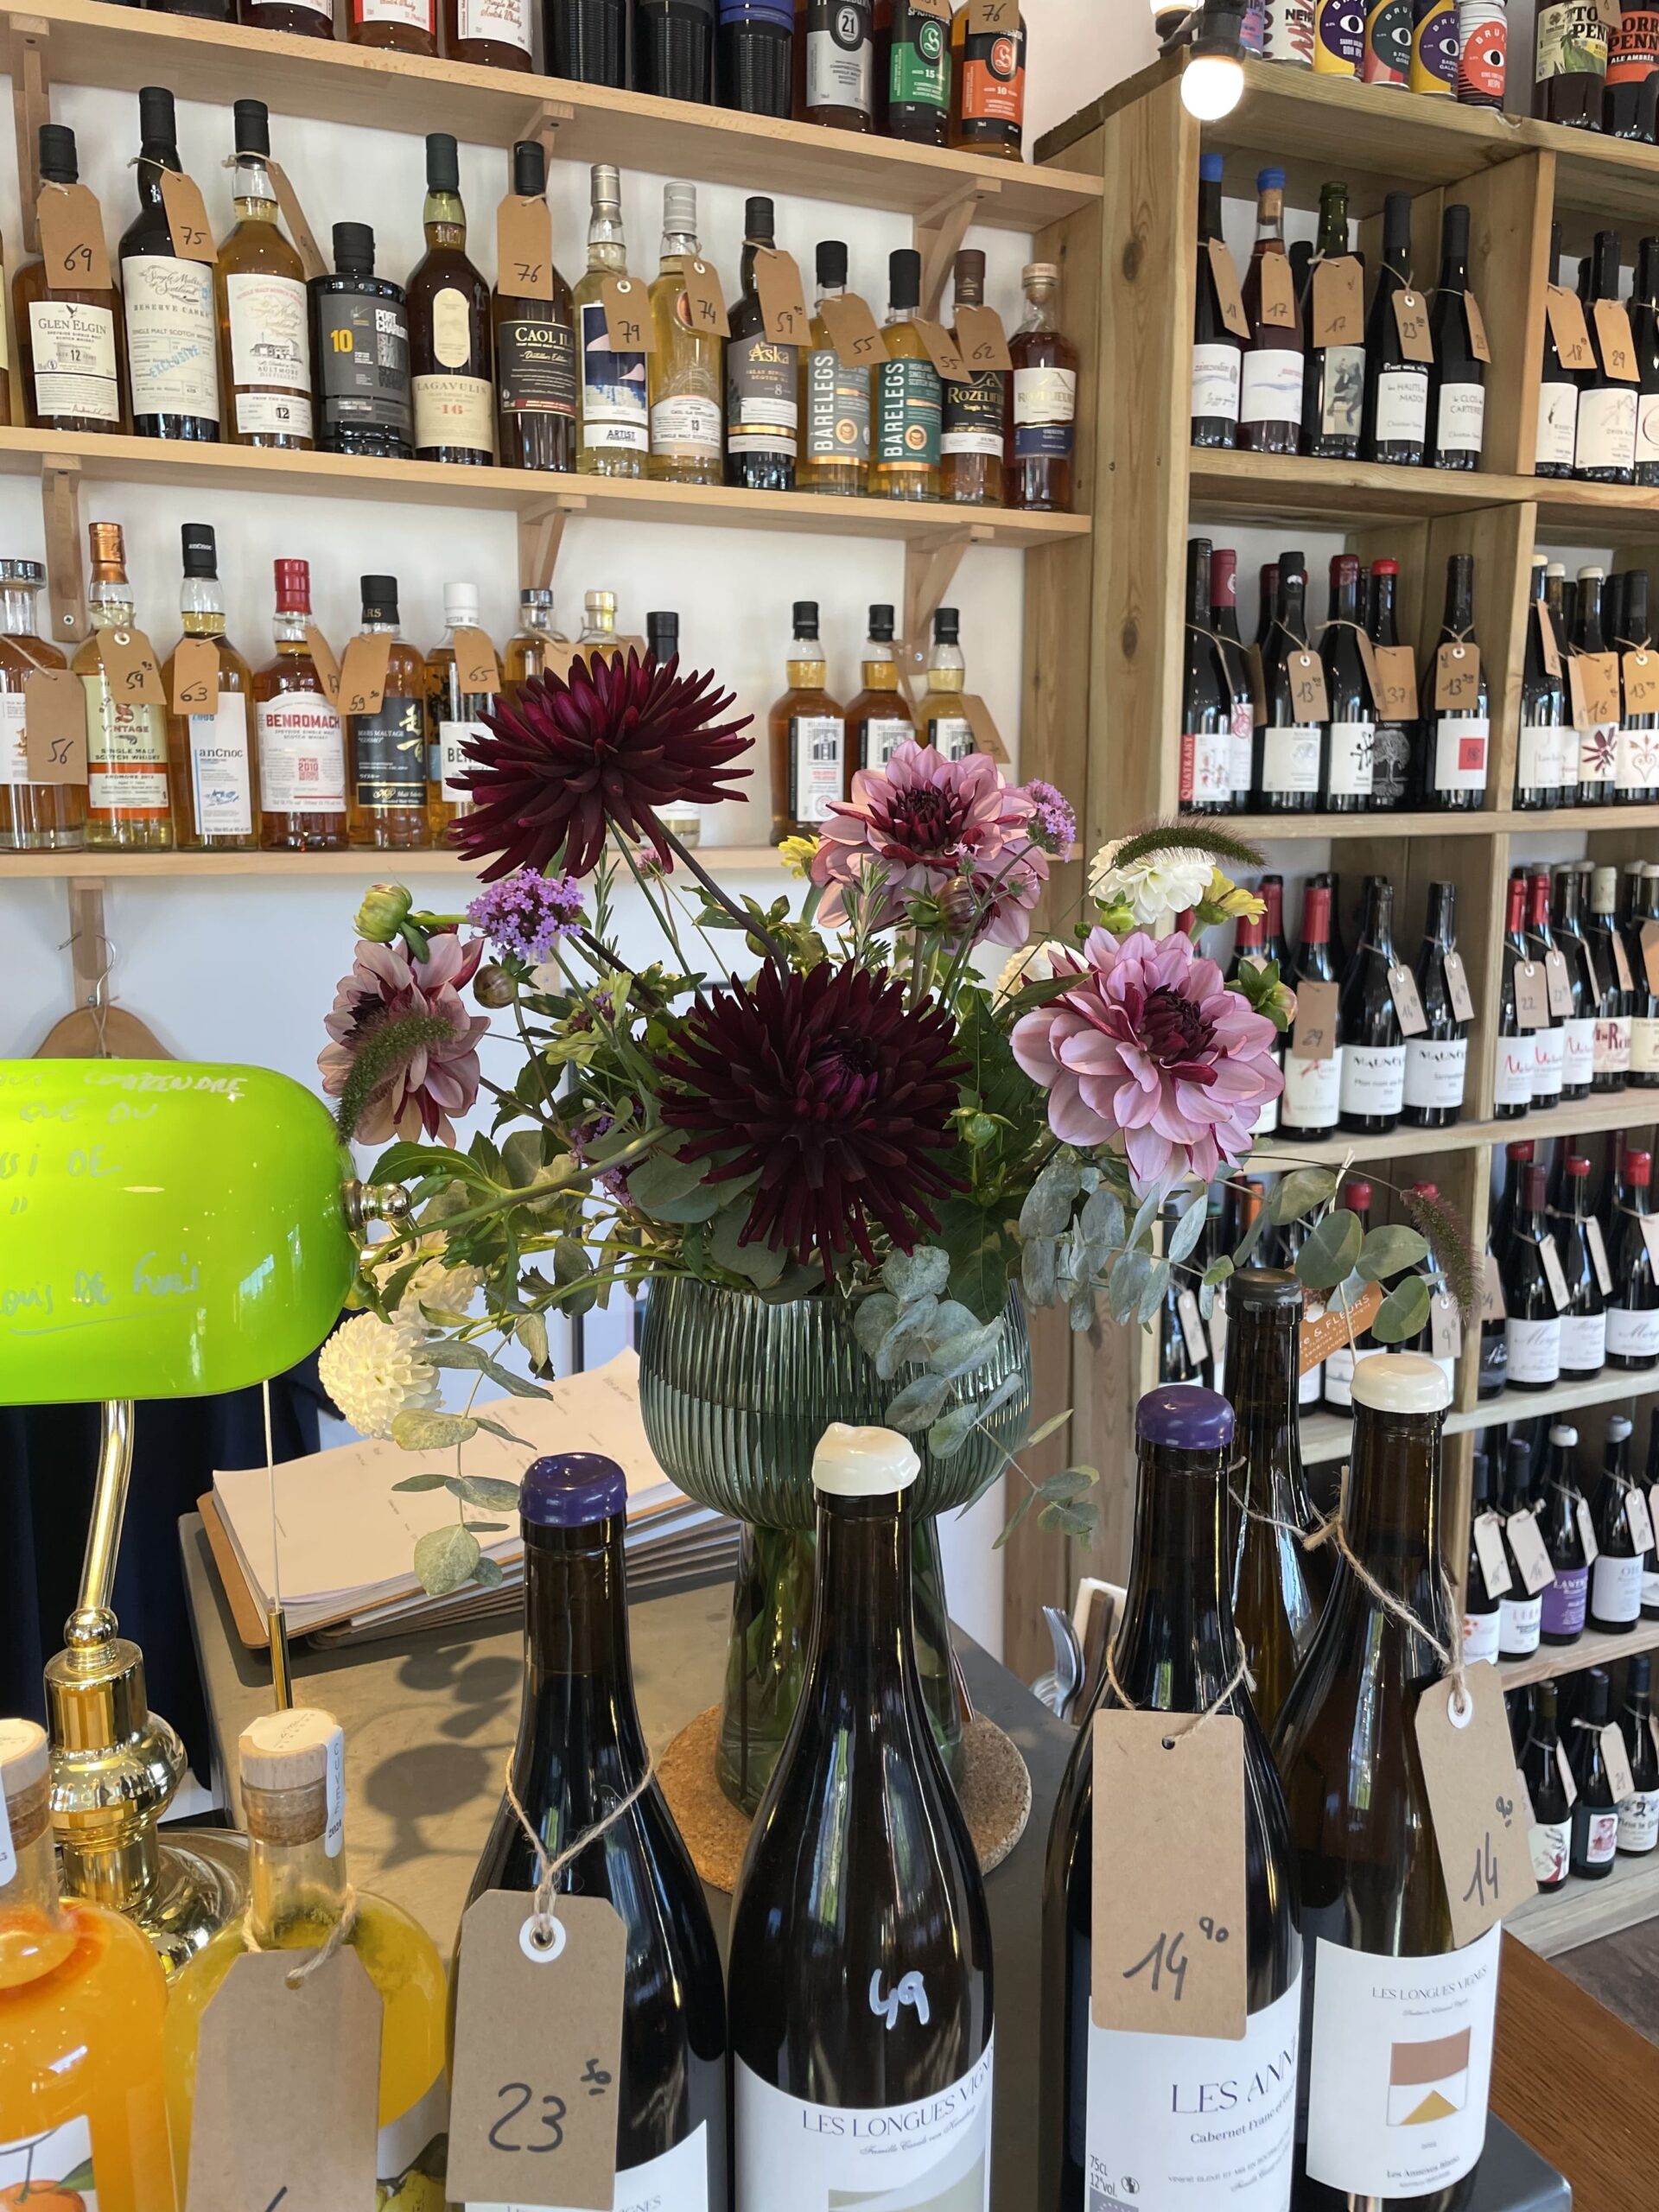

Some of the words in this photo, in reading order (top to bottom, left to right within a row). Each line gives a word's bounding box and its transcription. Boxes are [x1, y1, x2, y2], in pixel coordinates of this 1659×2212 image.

[982, 3, 1007, 22] 76
[842, 16, 855, 34] 21
[1476, 29, 1505, 45] BRU
[1608, 35, 1659, 52] PENN
[925, 69, 935, 79] 15
[997, 86, 1007, 95] 10
[181, 226, 206, 246] 75
[64, 244, 92, 272] 69
[514, 263, 543, 283] 76
[375, 308, 397, 322] PORT
[776, 311, 793, 334] 59
[38, 318, 70, 329] GLEN
[73, 320, 107, 334] ELGIN
[168, 329, 195, 338] SCOTCH
[617, 321, 640, 344] 79
[1325, 316, 1346, 333] 17
[1402, 322, 1418, 340] 23
[331, 329, 353, 353] 10
[515, 327, 556, 344] CAOL
[853, 336, 875, 354] 55
[972, 342, 995, 359] 62
[1567, 344, 1582, 361] 18
[71, 349, 80, 361] 12
[149, 345, 200, 378] EXCLUSIVE
[940, 355, 961, 370] 55
[1612, 350, 1625, 369] 29
[416, 381, 486, 395] LAGAVULIN
[774, 384, 783, 396] 8
[276, 407, 289, 419] 12
[442, 404, 463, 415] 16
[126, 671, 144, 690] 59
[468, 666, 496, 683] 65
[180, 681, 208, 702] 63
[266, 714, 340, 729] BENROMACH
[47, 738, 73, 764] 56
[199, 748, 244, 758] anCnoc
[298, 763, 319, 772] 2010
[1313, 1327, 1322, 1338] &
[1325, 1294, 1370, 1330] FLEURS
[1464, 1832, 1499, 1906] 14
[1122, 1931, 1189, 2002] 14
[1198, 1916, 1230, 1943] 90
[868, 1967, 931, 2031] 49
[1372, 1987, 1397, 2000] LES
[1400, 1983, 1456, 2001] LONGUES
[1172, 2080, 1238, 2114] LES
[1247, 2034, 1296, 2103] ANN
[802, 2109, 845, 2136] LES
[852, 2094, 955, 2138] LONGUES
[960, 2045, 994, 2101] VIGN
[487, 2082, 567, 2152] 23
[1190, 2125, 1246, 2144] Cabernet
